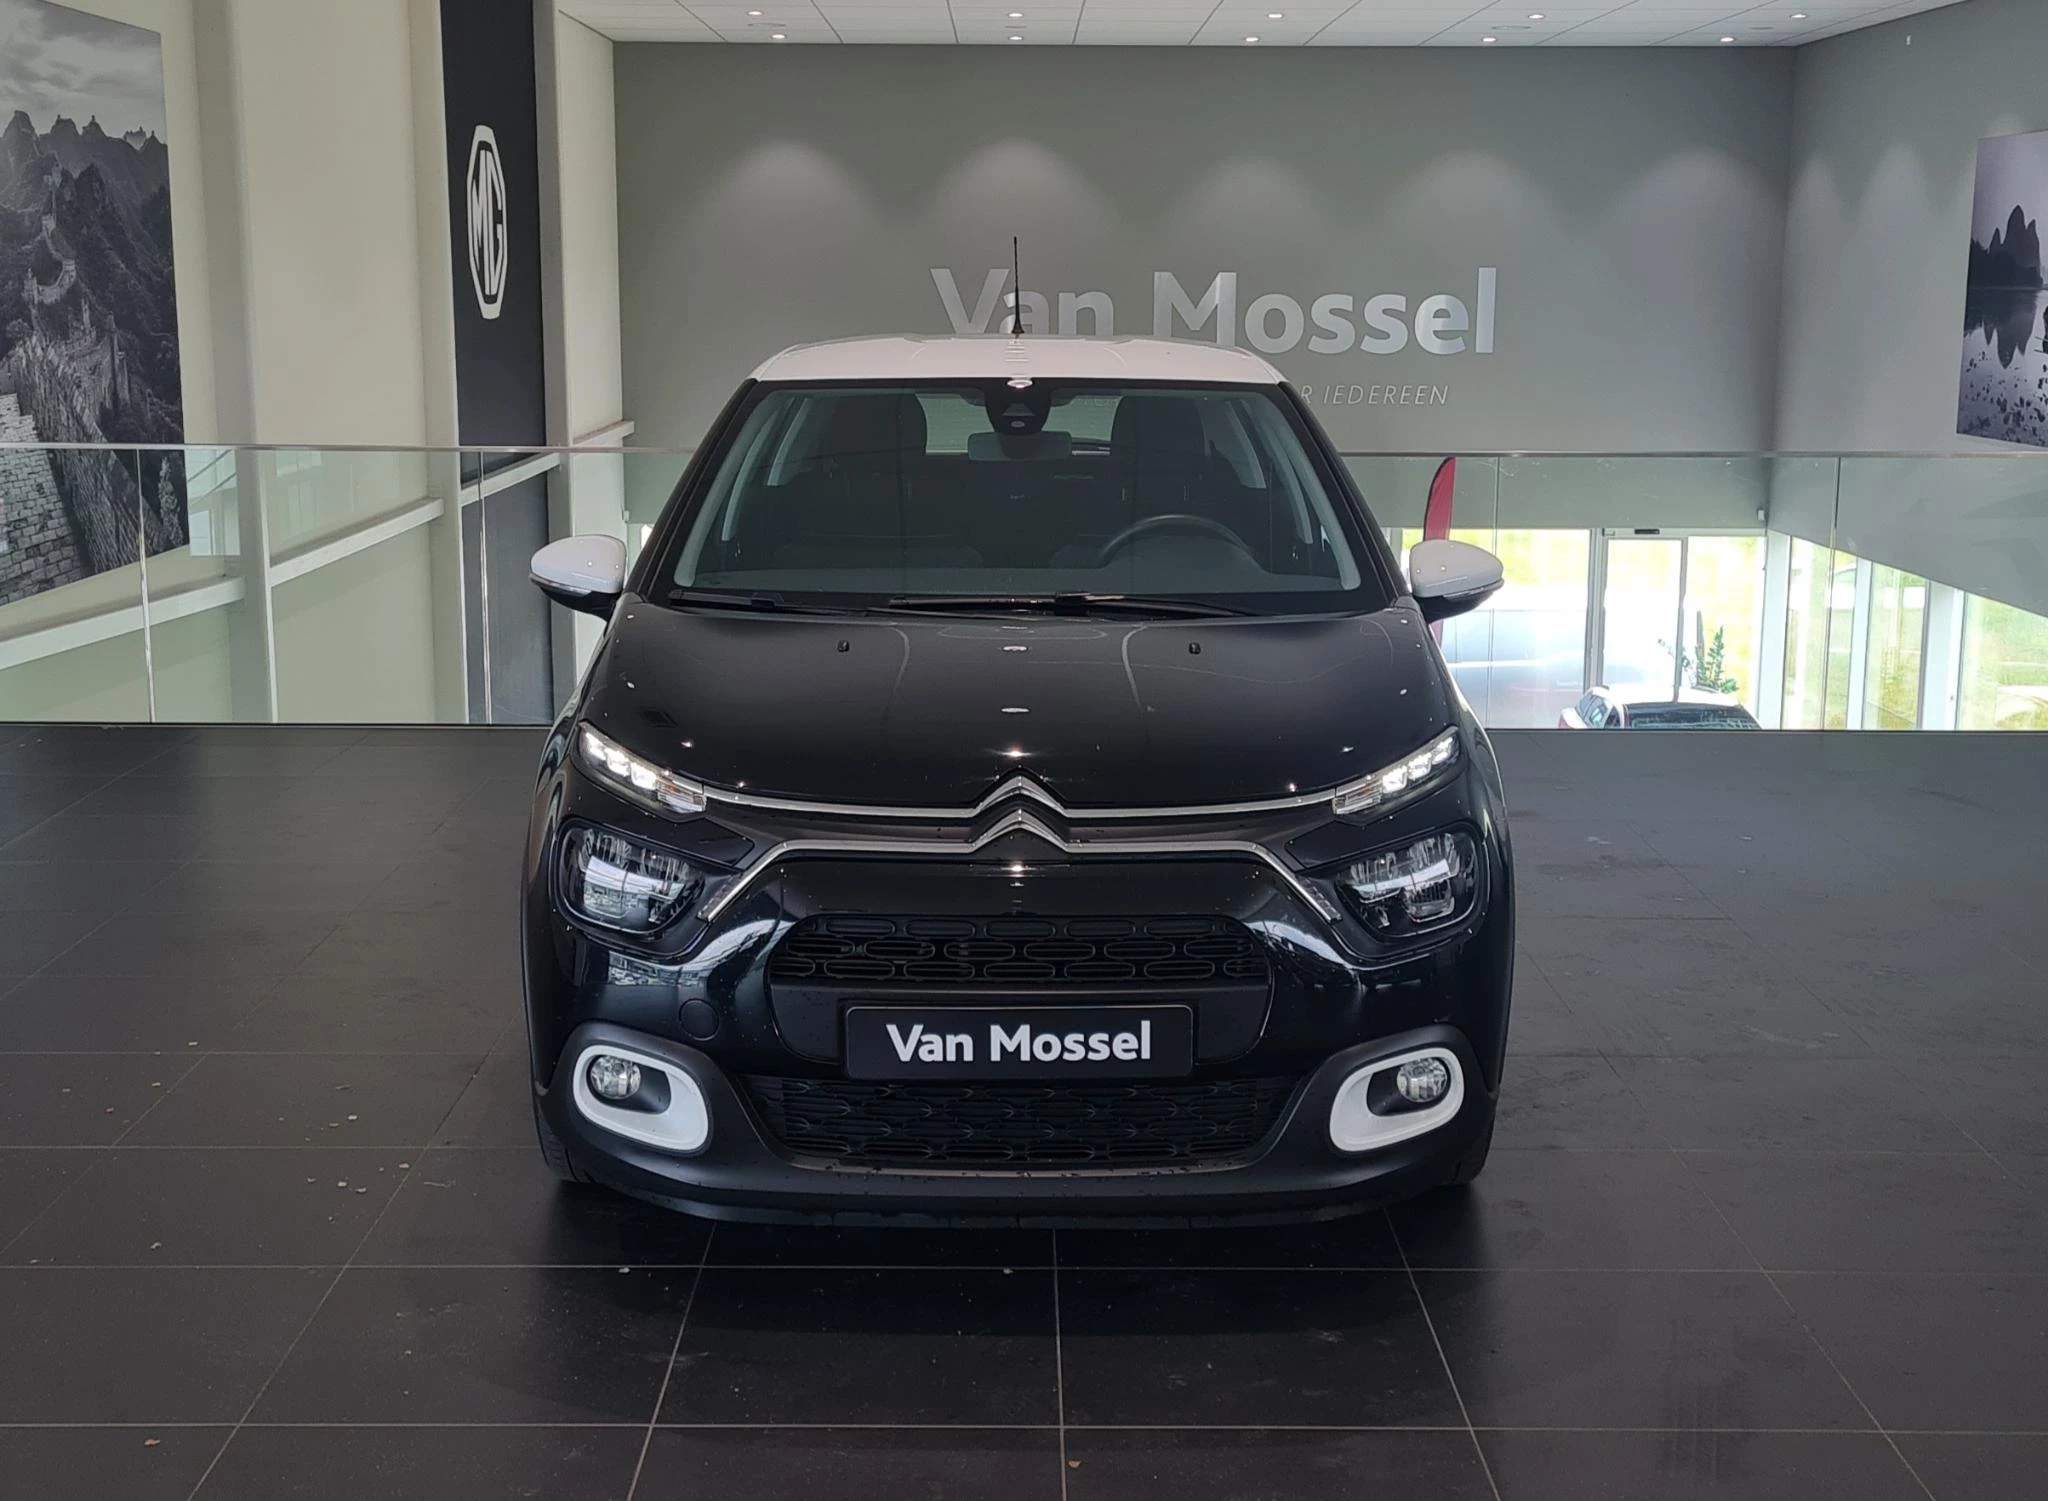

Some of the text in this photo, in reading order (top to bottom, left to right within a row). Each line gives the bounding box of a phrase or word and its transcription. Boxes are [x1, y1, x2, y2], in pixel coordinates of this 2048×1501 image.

[470, 148, 504, 297] MG
[930, 267, 1497, 354] Van Mossel
[1323, 384, 1449, 405] IEDEREEN
[886, 1020, 1151, 1062] Van Mossel
